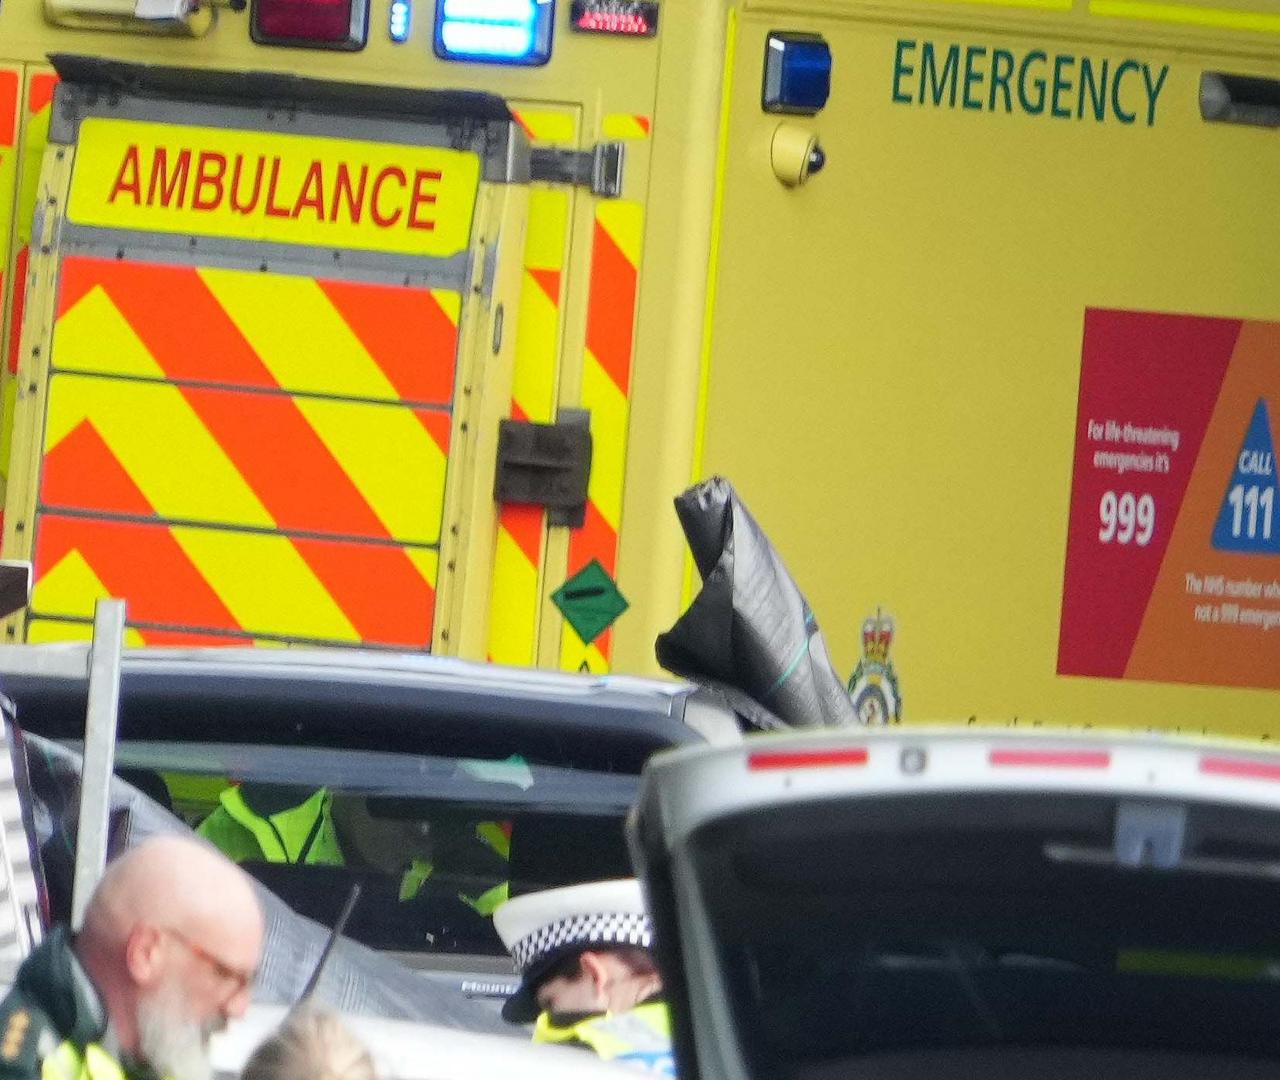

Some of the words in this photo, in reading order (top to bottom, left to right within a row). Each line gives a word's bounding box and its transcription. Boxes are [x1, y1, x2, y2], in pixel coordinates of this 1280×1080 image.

[892, 39, 1169, 127] EMERGENCY
[107, 144, 443, 231] AMBULANCE
[1088, 419, 1104, 440] For
[1094, 451, 1154, 473] emergencies
[1238, 450, 1273, 476] CALL
[1099, 491, 1155, 546] 999
[1228, 485, 1275, 540] 111
[1186, 573, 1202, 594] The
